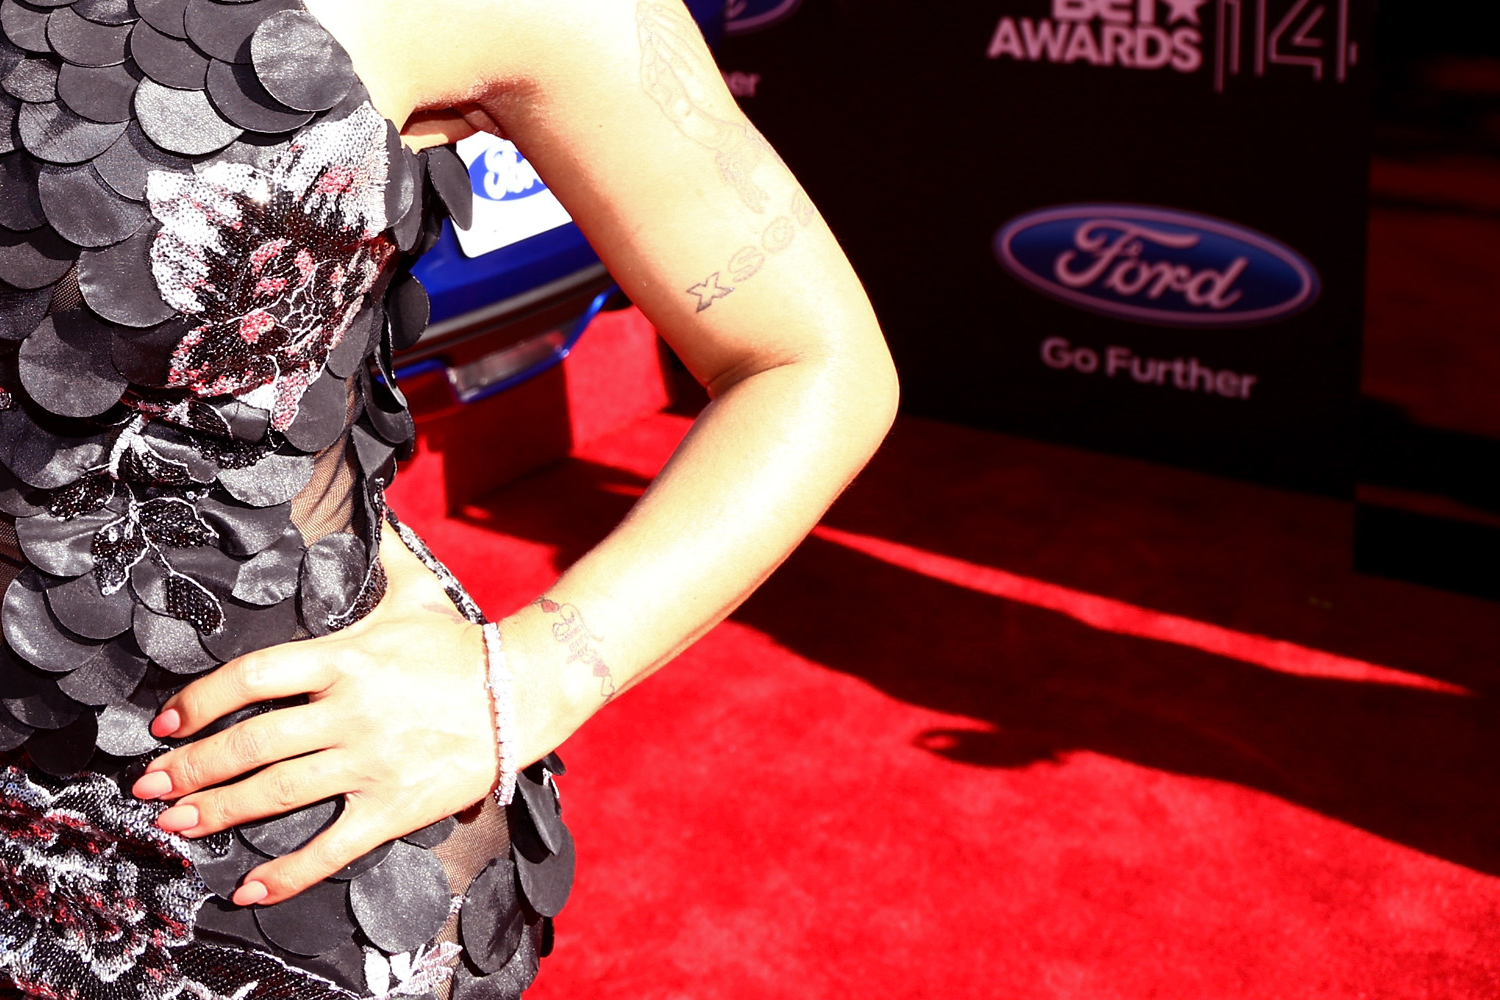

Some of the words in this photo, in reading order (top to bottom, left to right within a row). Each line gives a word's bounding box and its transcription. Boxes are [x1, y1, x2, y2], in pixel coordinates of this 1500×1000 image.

[986, 17, 1202, 72] AWARDS
[1054, 218, 1248, 309] Ford
[1041, 336, 1098, 373] Go
[1105, 346, 1257, 401] Further
